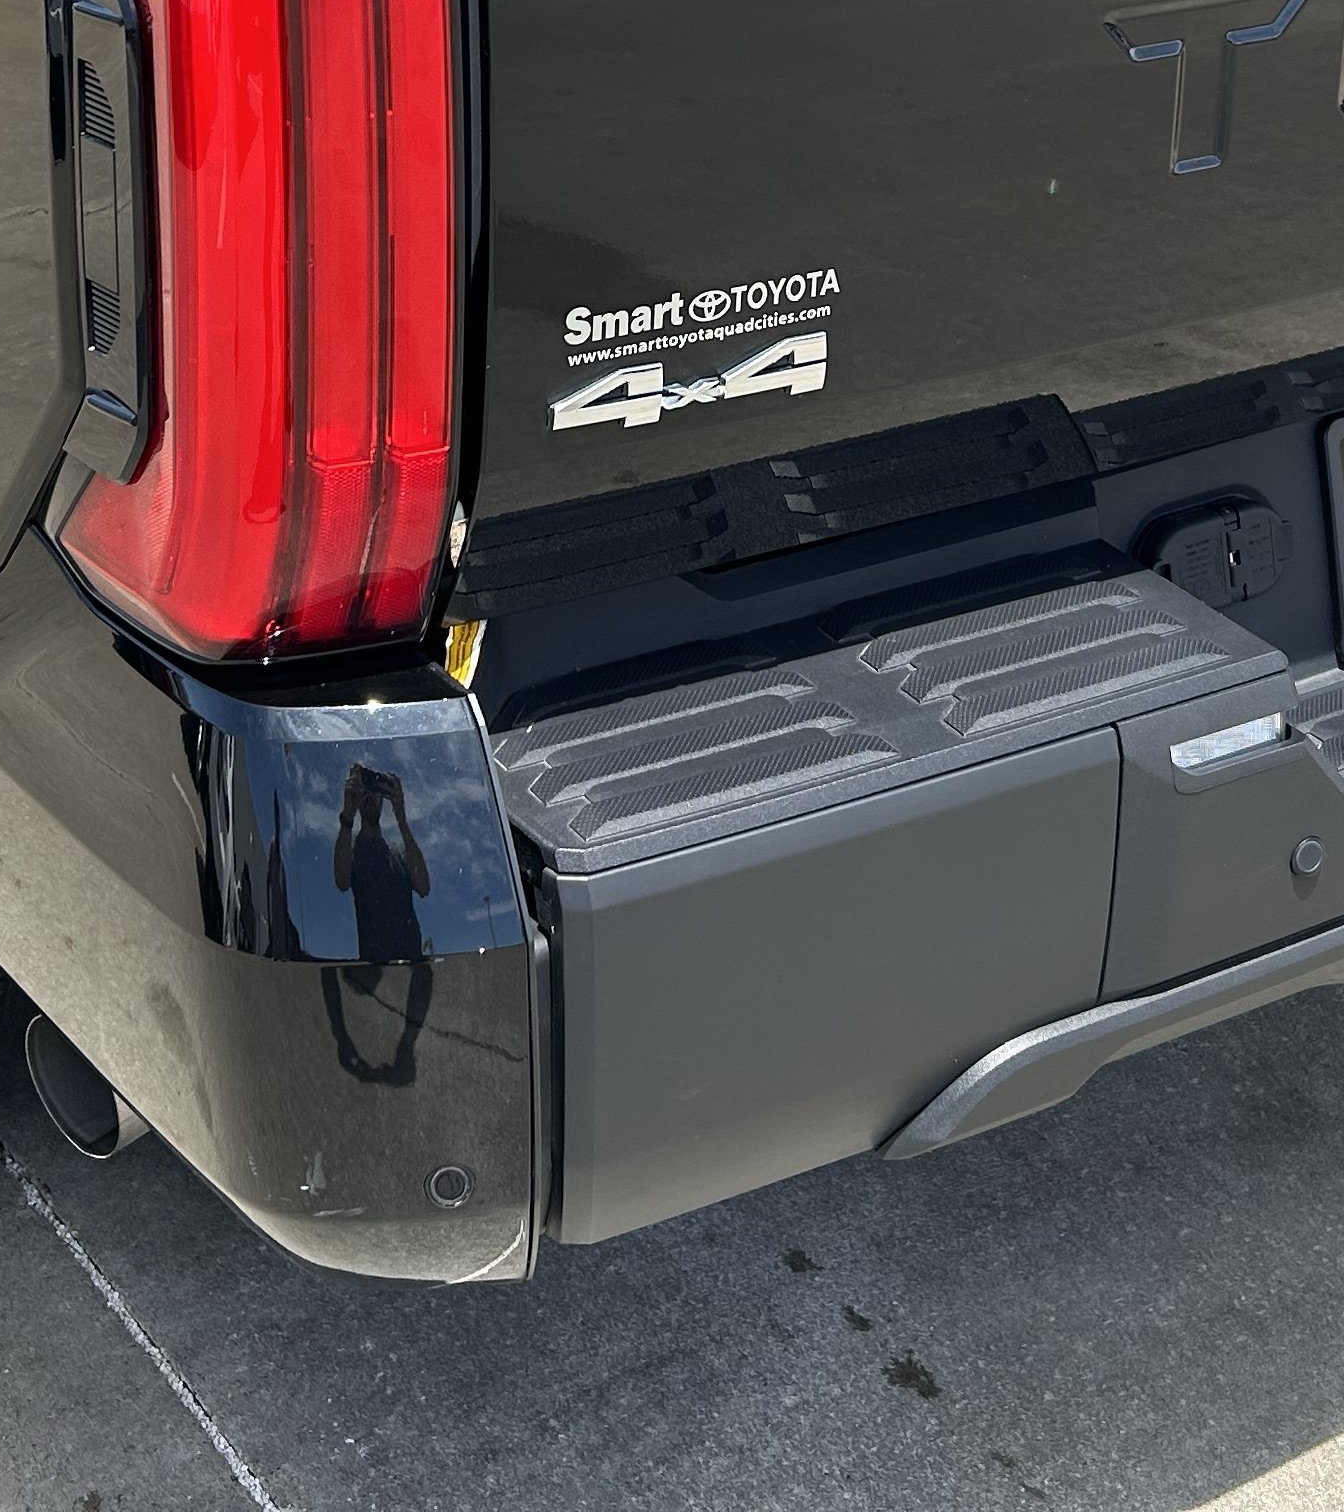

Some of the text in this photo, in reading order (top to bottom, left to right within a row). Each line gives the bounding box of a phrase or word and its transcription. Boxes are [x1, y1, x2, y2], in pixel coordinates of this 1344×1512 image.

[563, 268, 841, 346] Smart TOYOTA
[567, 305, 832, 367] www.smarttoyotaquadcities.com
[547, 331, 828, 431] 4x4
